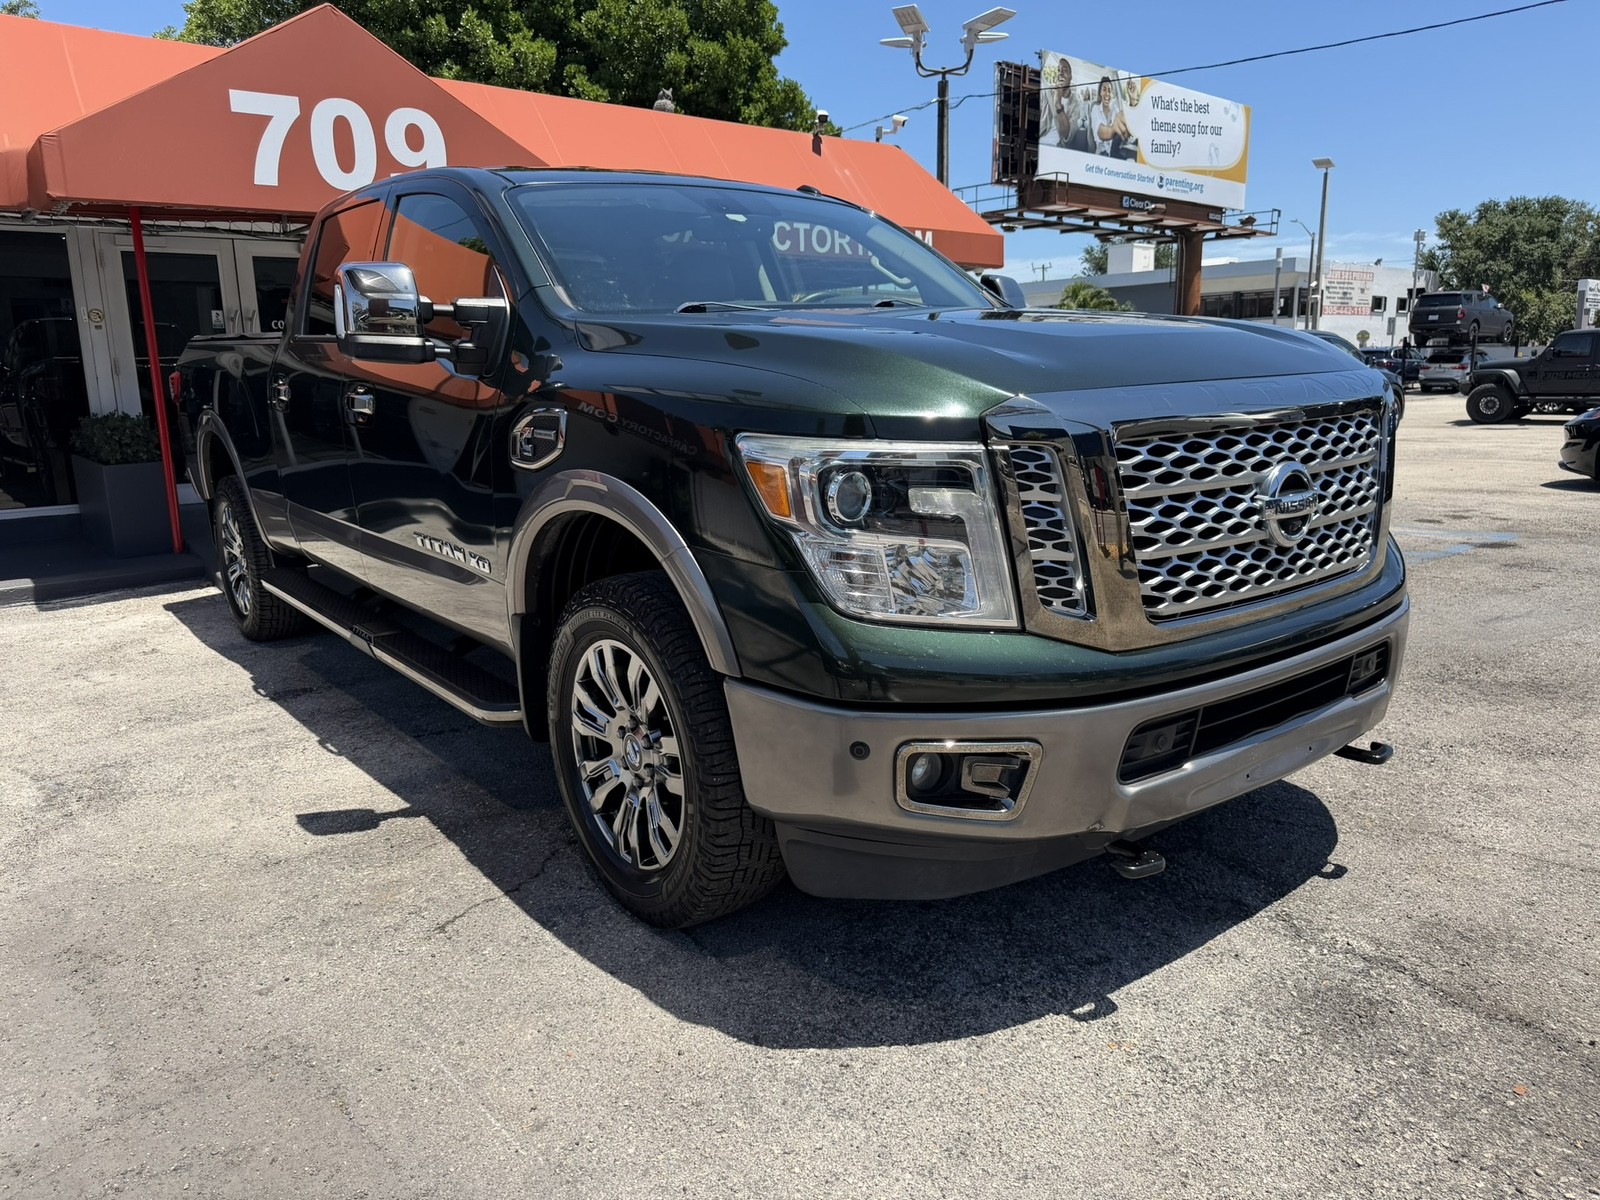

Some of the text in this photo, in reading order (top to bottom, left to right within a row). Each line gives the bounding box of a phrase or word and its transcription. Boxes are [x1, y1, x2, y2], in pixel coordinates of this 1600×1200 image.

[1151, 96, 1210, 114] What's the best
[1151, 117, 1223, 138] theme song for our
[229, 89, 447, 191] 709
[1151, 139, 1181, 158] family?
[1085, 164, 1155, 184] Get the Conversation Started
[1165, 178, 1204, 194] parenting.org
[1275, 494, 1317, 515] NISSAN
[413, 531, 491, 574] TITAN XD
